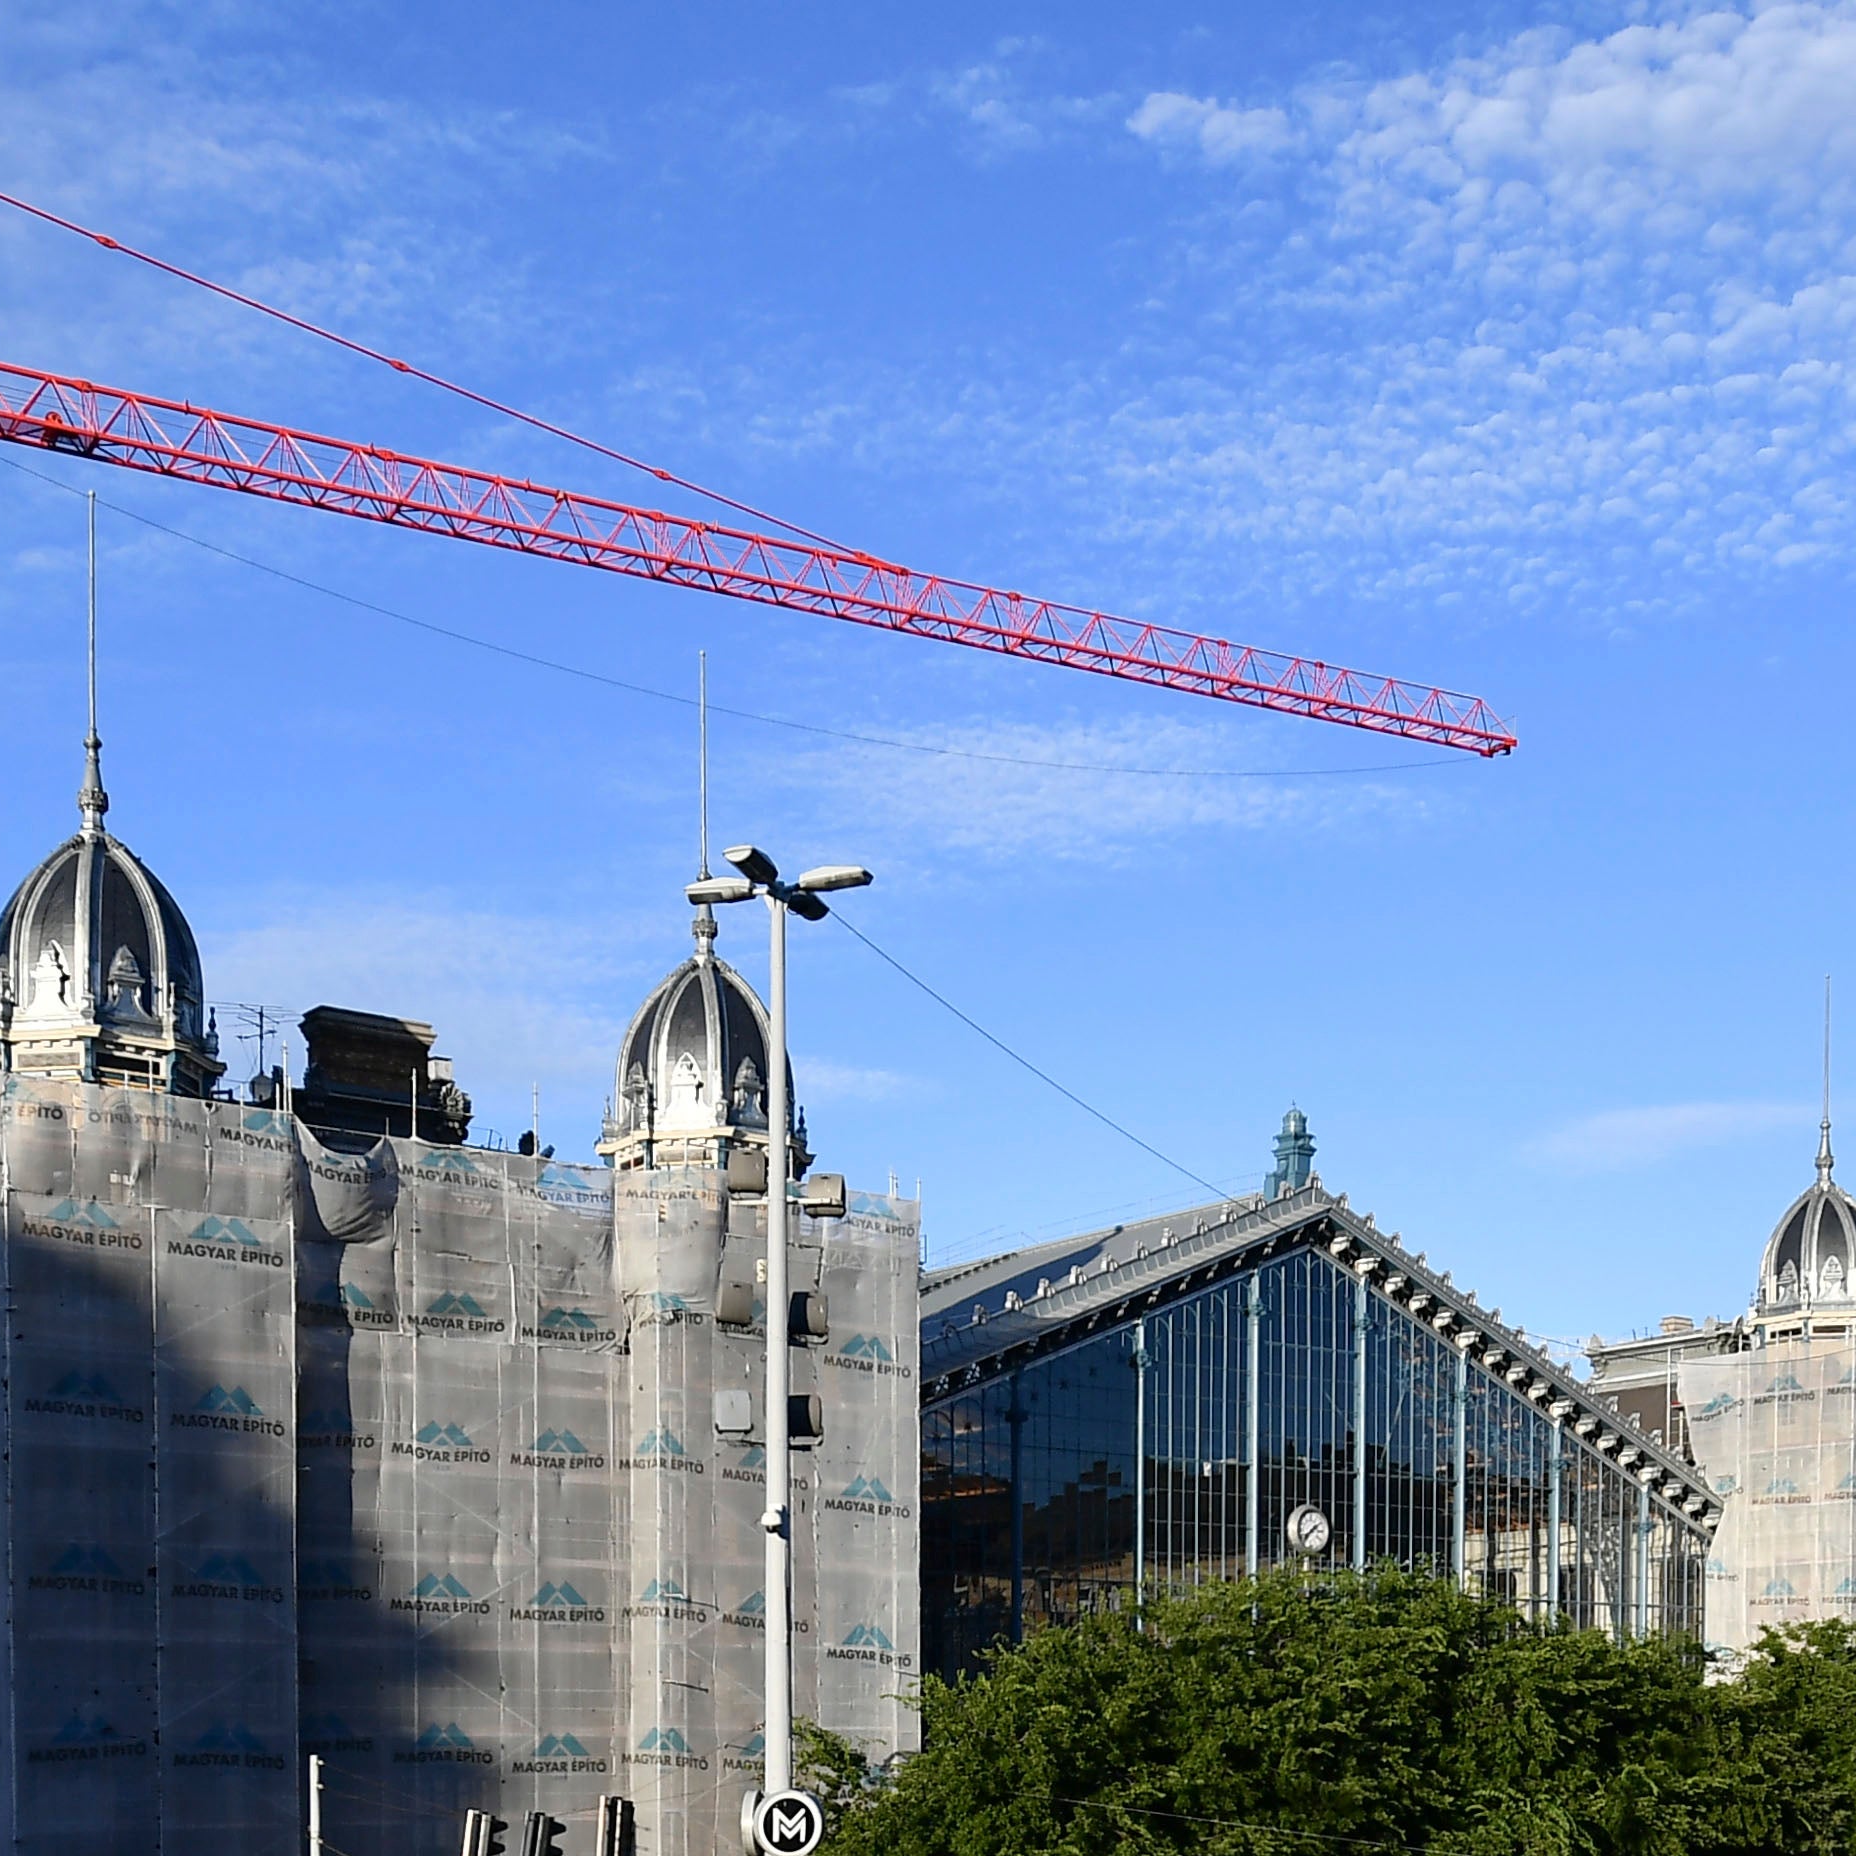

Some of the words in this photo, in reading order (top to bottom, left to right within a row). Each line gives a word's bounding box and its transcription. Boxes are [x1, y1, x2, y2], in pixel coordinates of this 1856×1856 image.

[220, 1127, 284, 1153] MAGYAR
[22, 1222, 95, 1246] MAGYAR
[99, 1229, 143, 1250] ÉPÍTŐ
[167, 1240, 237, 1261] MAGYAR
[241, 1246, 284, 1268] ÉPÍTŐ
[354, 1308, 394, 1325] ÉPÍTŐ
[407, 1314, 464, 1330] MAGYAR
[468, 1315, 505, 1333] ÉPÍTŐ
[521, 1327, 577, 1342] MAGYAR
[580, 1327, 617, 1343] ÉPÍTŐ
[824, 1354, 874, 1372] MAGYAR
[24, 1399, 95, 1418] MAGYAR
[170, 1412, 239, 1432] MAGYAR
[243, 1415, 285, 1437] ÉPÍTŐ
[391, 1441, 450, 1462] MAGYAR
[454, 1447, 491, 1464] ÉPÍTŐ
[510, 1453, 565, 1469] MAGYAR
[569, 1453, 605, 1470] ÉPÍTŐ
[670, 1457, 704, 1475] ÉPÍTŐ
[723, 1467, 766, 1484] MAGYA
[824, 1498, 875, 1515] MAGYAR
[171, 1583, 239, 1600] MAGYAR
[389, 1598, 451, 1614] MAGYAR
[453, 1599, 491, 1615] ÉPÍTŐ
[509, 1607, 565, 1622] MAGYAR
[569, 1607, 605, 1622] ÉPÍTŐ
[673, 1605, 707, 1623] ÉPÍTŐ
[722, 1613, 766, 1630] MAGYA
[826, 1647, 877, 1662] MAGYAR
[392, 1750, 452, 1764] MAGYAR
[456, 1748, 494, 1764] ÉPÍTŐ
[621, 1753, 672, 1766] MAGYAR
[675, 1752, 709, 1771] ÉPÍTŐ
[723, 1757, 766, 1771] MAGYA
[512, 1760, 568, 1773] MAGYAR
[571, 1757, 607, 1773] ÉPÍTŐ
